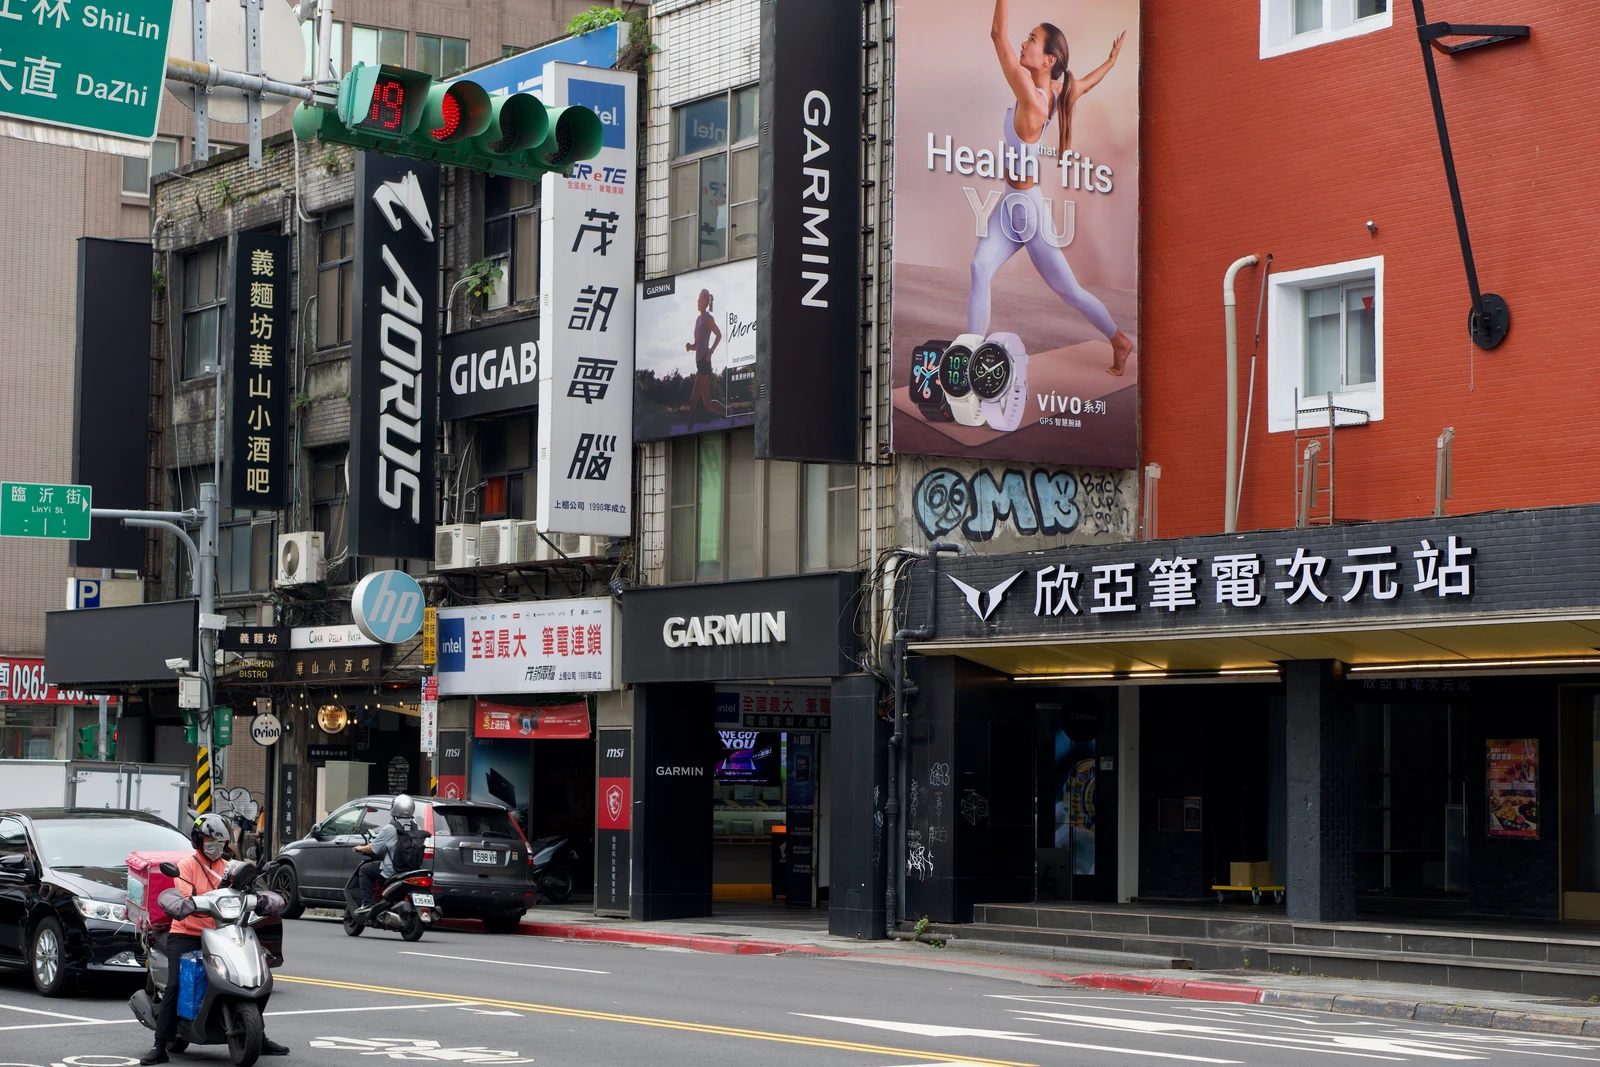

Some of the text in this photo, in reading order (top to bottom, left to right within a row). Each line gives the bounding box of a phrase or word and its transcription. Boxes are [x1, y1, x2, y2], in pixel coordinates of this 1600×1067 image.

[82, 5, 160, 40] ShiLin
[76, 73, 148, 106] DaZhi
[927, 132, 1113, 193] Health that fits
[801, 89, 831, 308] GARMIN
[962, 186, 1075, 247] YOU
[646, 284, 671, 295] GARMIN
[729, 312, 738, 325] Be
[728, 319, 758, 342] More
[449, 340, 540, 395] GIGAB
[922, 351, 937, 370] 12
[949, 356, 961, 370] 10
[246, 249, 275, 494] 義麵坊華山小酒吧
[948, 370, 960, 384] 10
[379, 244, 423, 524] AORUS
[1083, 399, 1106, 415] 系列
[1040, 417, 1054, 425] GPS
[11, 485, 82, 505] 臨沂街
[554, 500, 627, 514] 上櫃公司 1990年成立
[1033, 535, 1473, 617] 欣亞筆電次元站
[79, 581, 99, 608] P
[368, 570, 421, 643] hp
[662, 610, 786, 648] GARMIN
[239, 632, 278, 644] 義麵坊
[441, 638, 463, 655] intel
[471, 624, 602, 659] 全國最大 筆電連鎖
[238, 670, 268, 679] BISTRO
[296, 658, 370, 677] 華山小酒吧
[717, 703, 737, 713] intel
[743, 696, 794, 713] 全國最大
[253, 726, 280, 738] Orion
[718, 731, 760, 739] WE GOT
[445, 748, 461, 757] msi
[721, 739, 756, 749] YOU
[606, 748, 625, 758] msi
[656, 766, 704, 776] GARMIN
